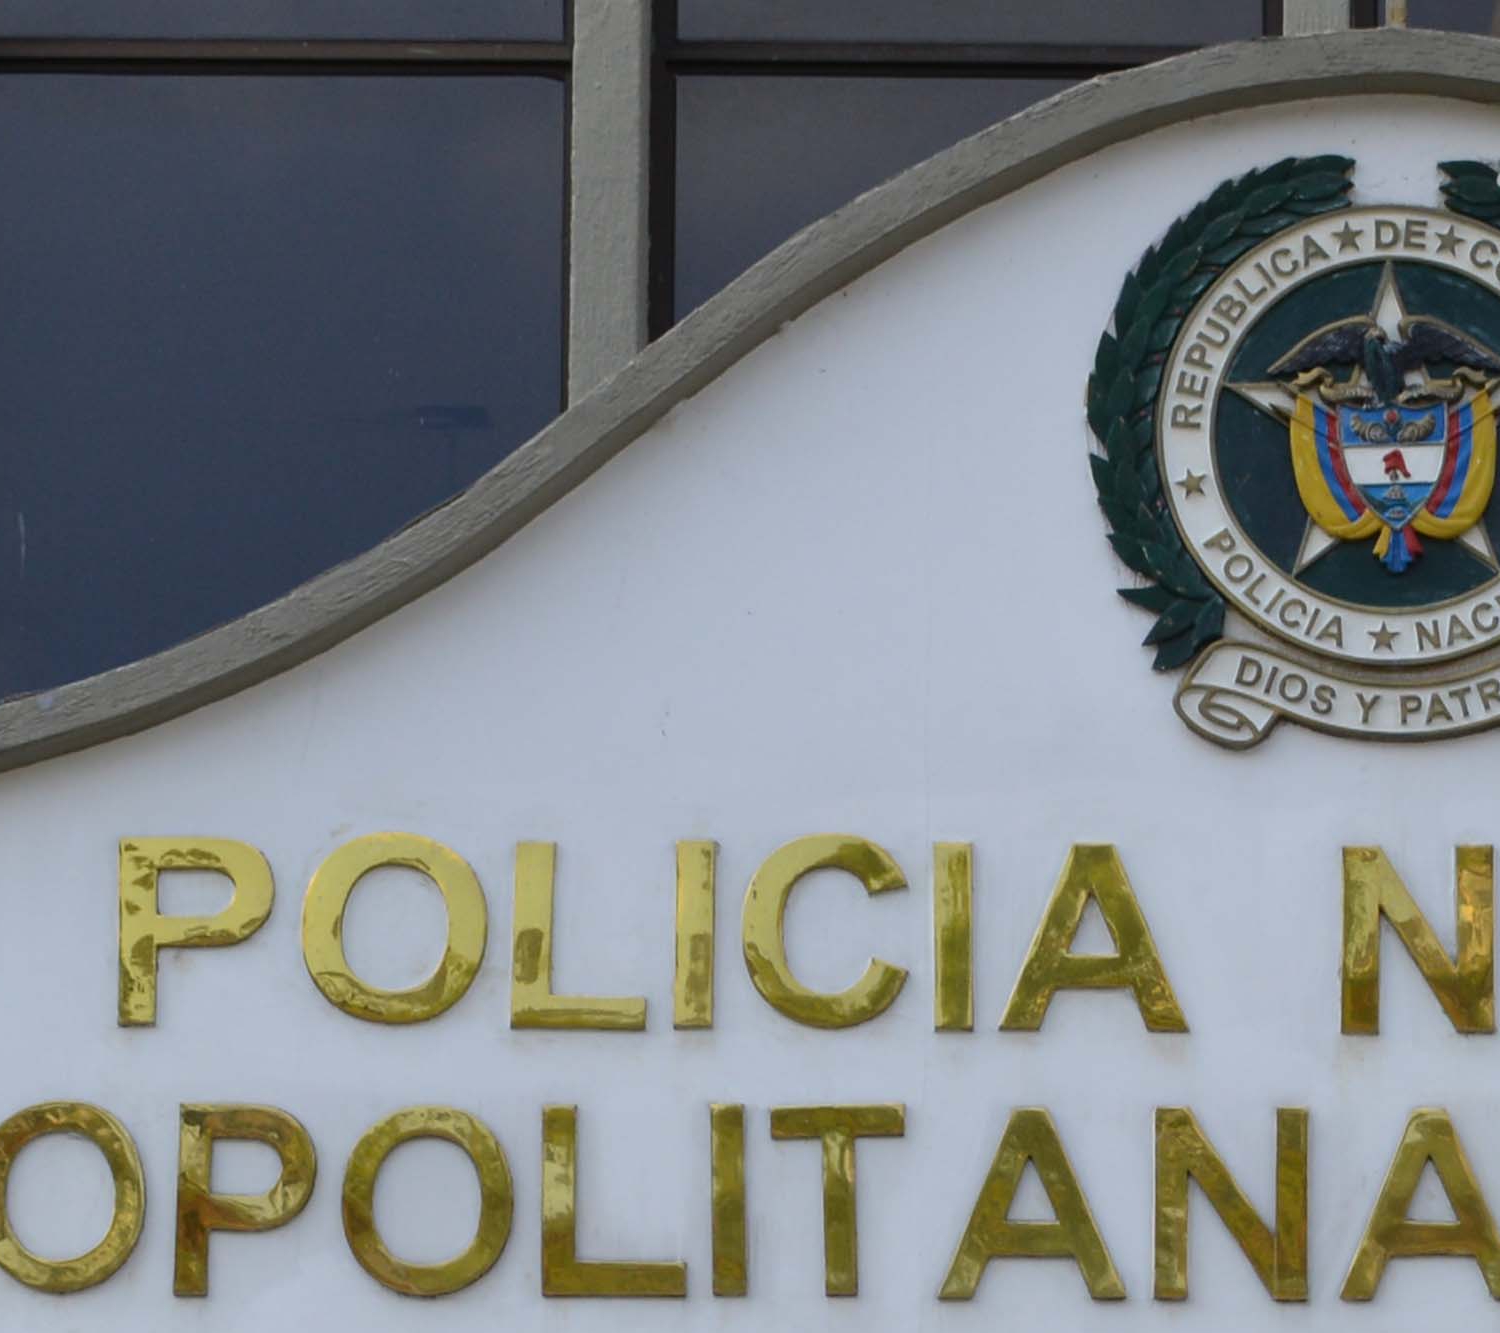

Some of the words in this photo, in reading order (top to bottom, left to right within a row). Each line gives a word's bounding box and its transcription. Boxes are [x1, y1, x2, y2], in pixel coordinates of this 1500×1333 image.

[1170, 234, 1331, 430] REPUBLICA
[1374, 219, 1429, 250] DE
[1203, 527, 1346, 649] POLICIA
[1234, 654, 1338, 716] DIOS
[1353, 693, 1383, 725] Y
[116, 830, 1189, 1034] POLICIA
